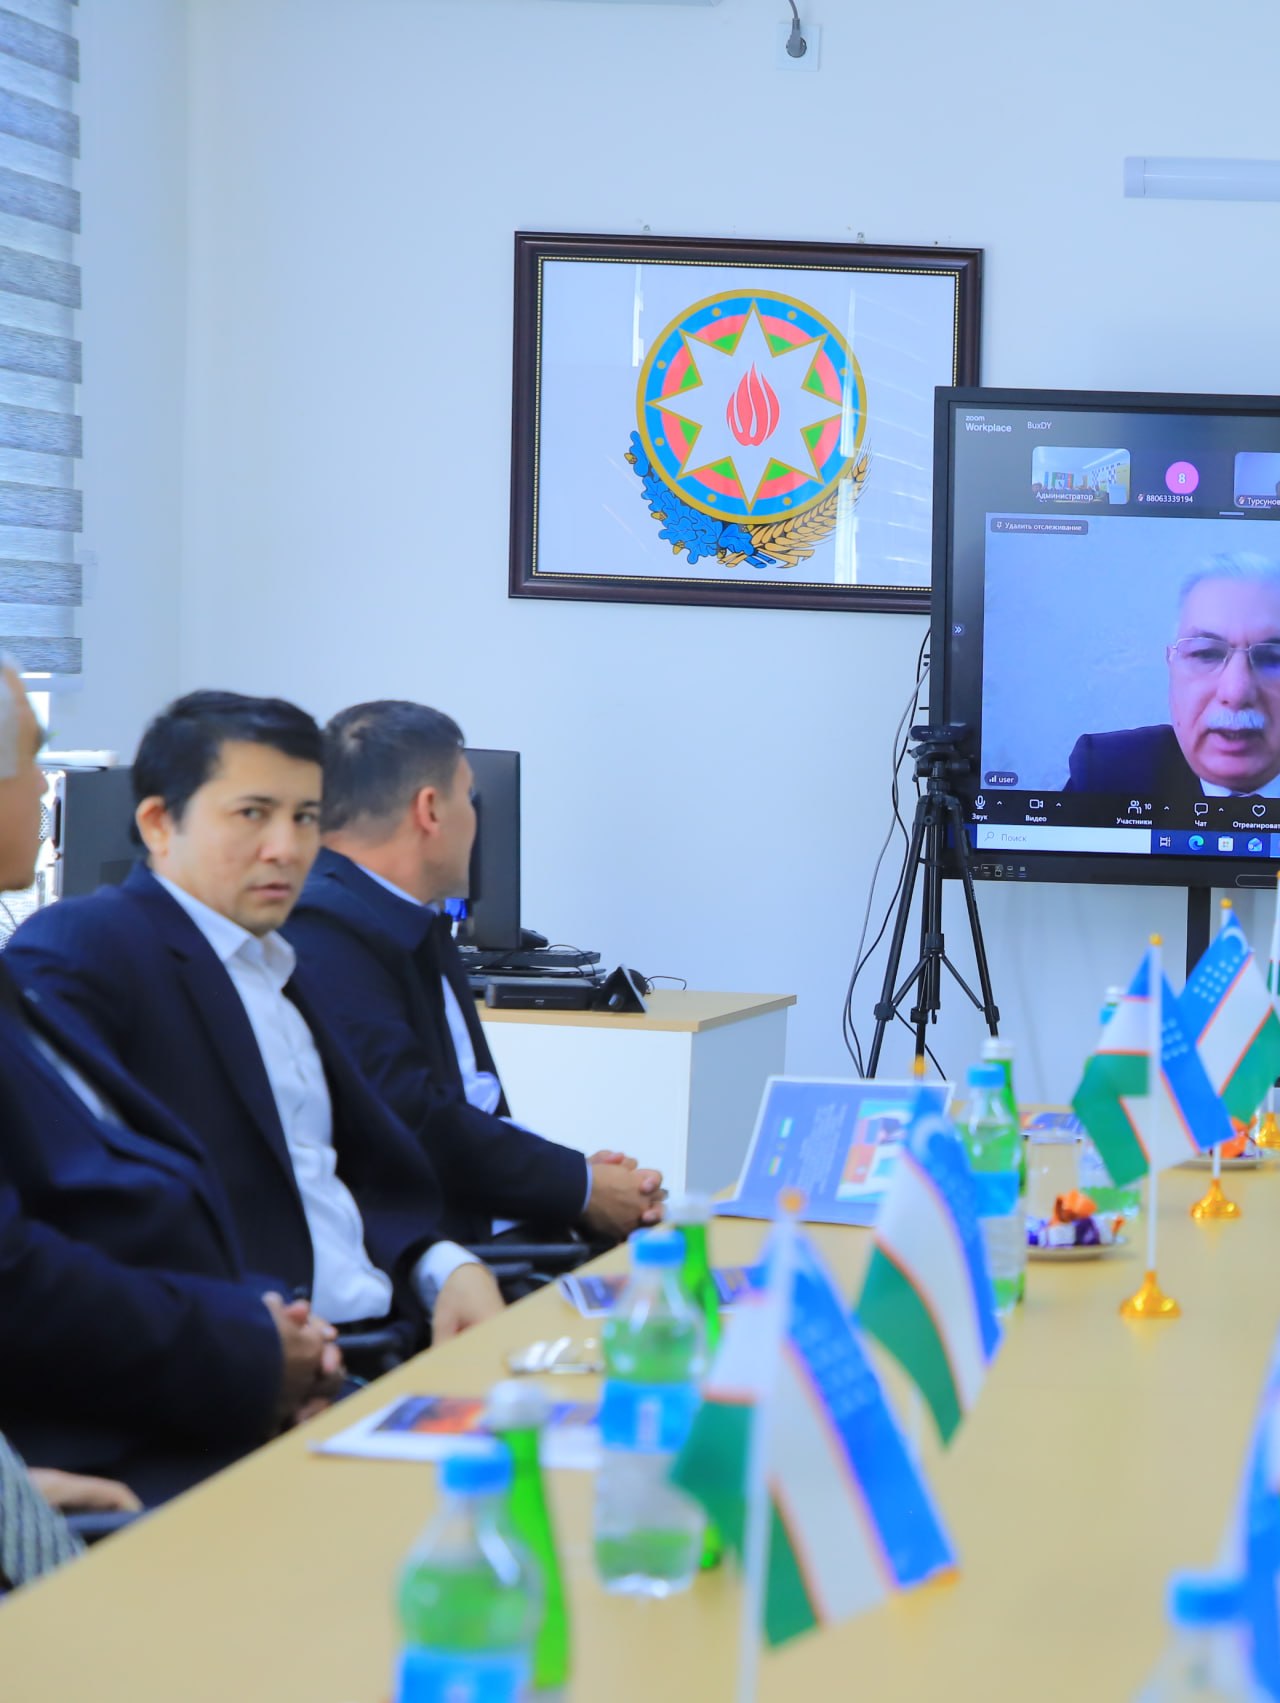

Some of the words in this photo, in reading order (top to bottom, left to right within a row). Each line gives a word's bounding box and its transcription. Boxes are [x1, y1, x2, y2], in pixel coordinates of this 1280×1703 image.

[966, 422, 1012, 433] Workplace
[1027, 421, 1052, 430] BuxDY
[1178, 473, 1186, 484] 8
[1035, 492, 1094, 501] Администратор
[1146, 495, 1193, 503] 88063339194
[1247, 497, 1280, 506] Турсунов
[1005, 521, 1032, 530] Удалить
[1034, 523, 1082, 531] отслеживание
[971, 813, 988, 821] Звук
[1025, 815, 1047, 823] Видео
[1116, 817, 1152, 825] Участники
[1001, 833, 1027, 842] Поиск
